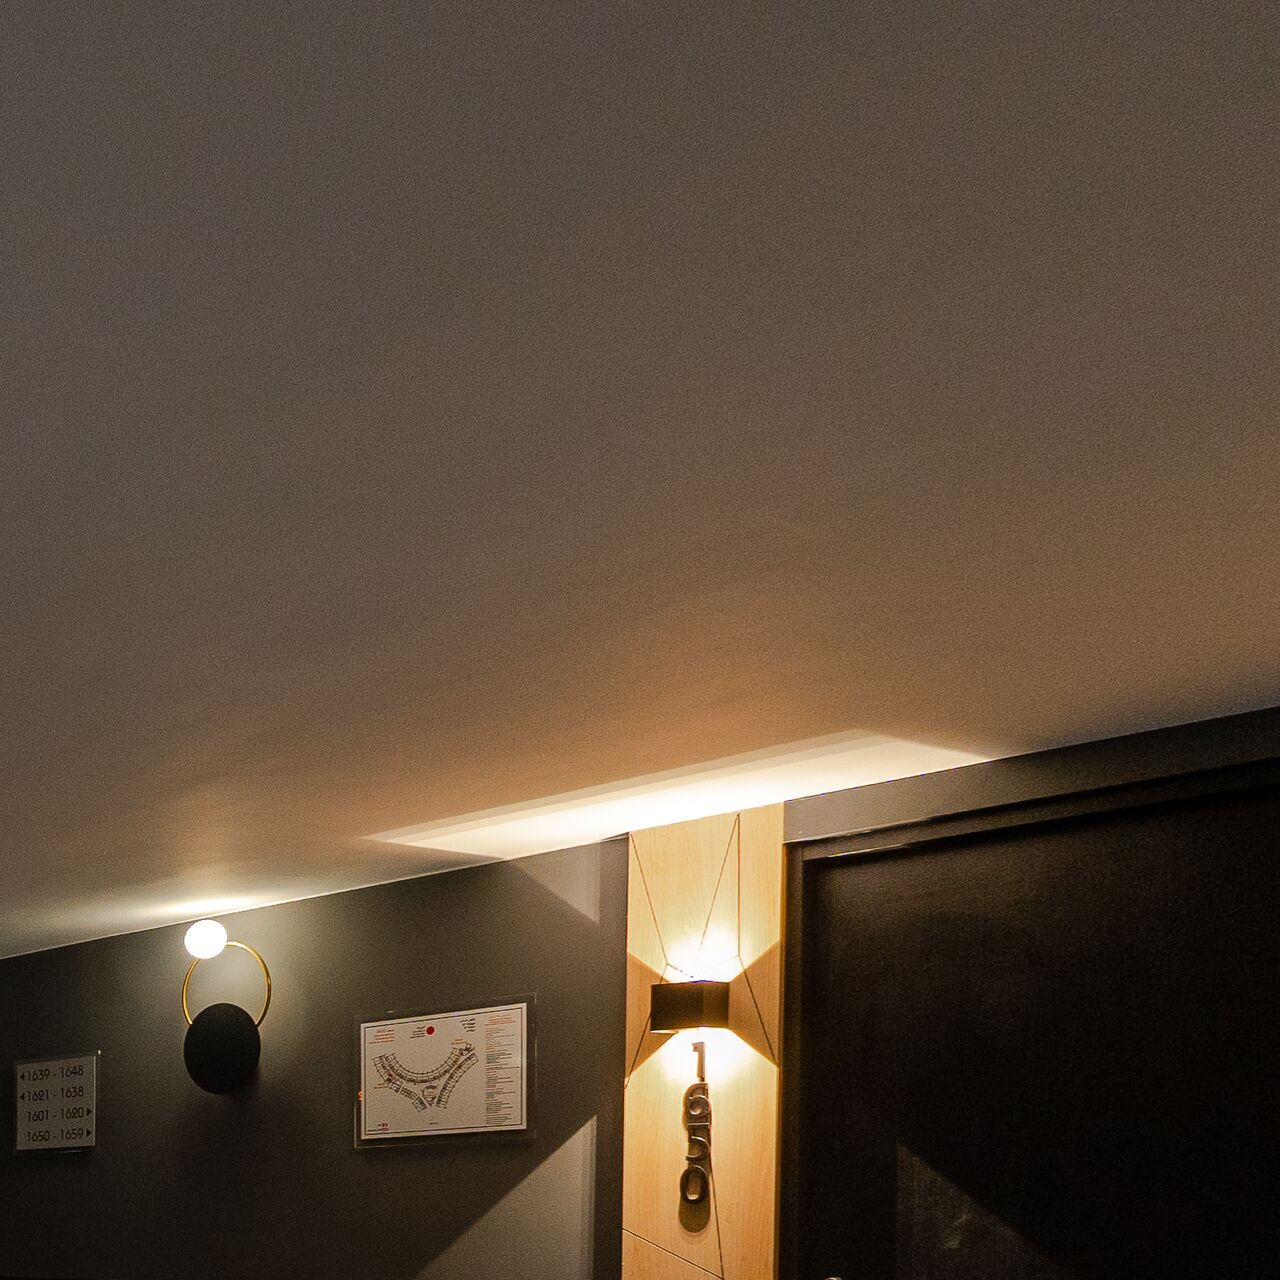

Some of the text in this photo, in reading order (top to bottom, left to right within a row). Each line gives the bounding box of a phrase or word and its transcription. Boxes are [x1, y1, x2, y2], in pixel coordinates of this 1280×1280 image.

[26, 1068, 50, 1081] 1639
[60, 1065, 84, 1078] 1648
[27, 1089, 49, 1101] 1621
[60, 1086, 84, 1098] 1638
[27, 1109, 49, 1121] 1601
[60, 1107, 84, 1119] 1620
[683, 1042, 711, 1204] 1650
[27, 1130, 50, 1142] 1650
[60, 1128, 84, 1140] 1659
